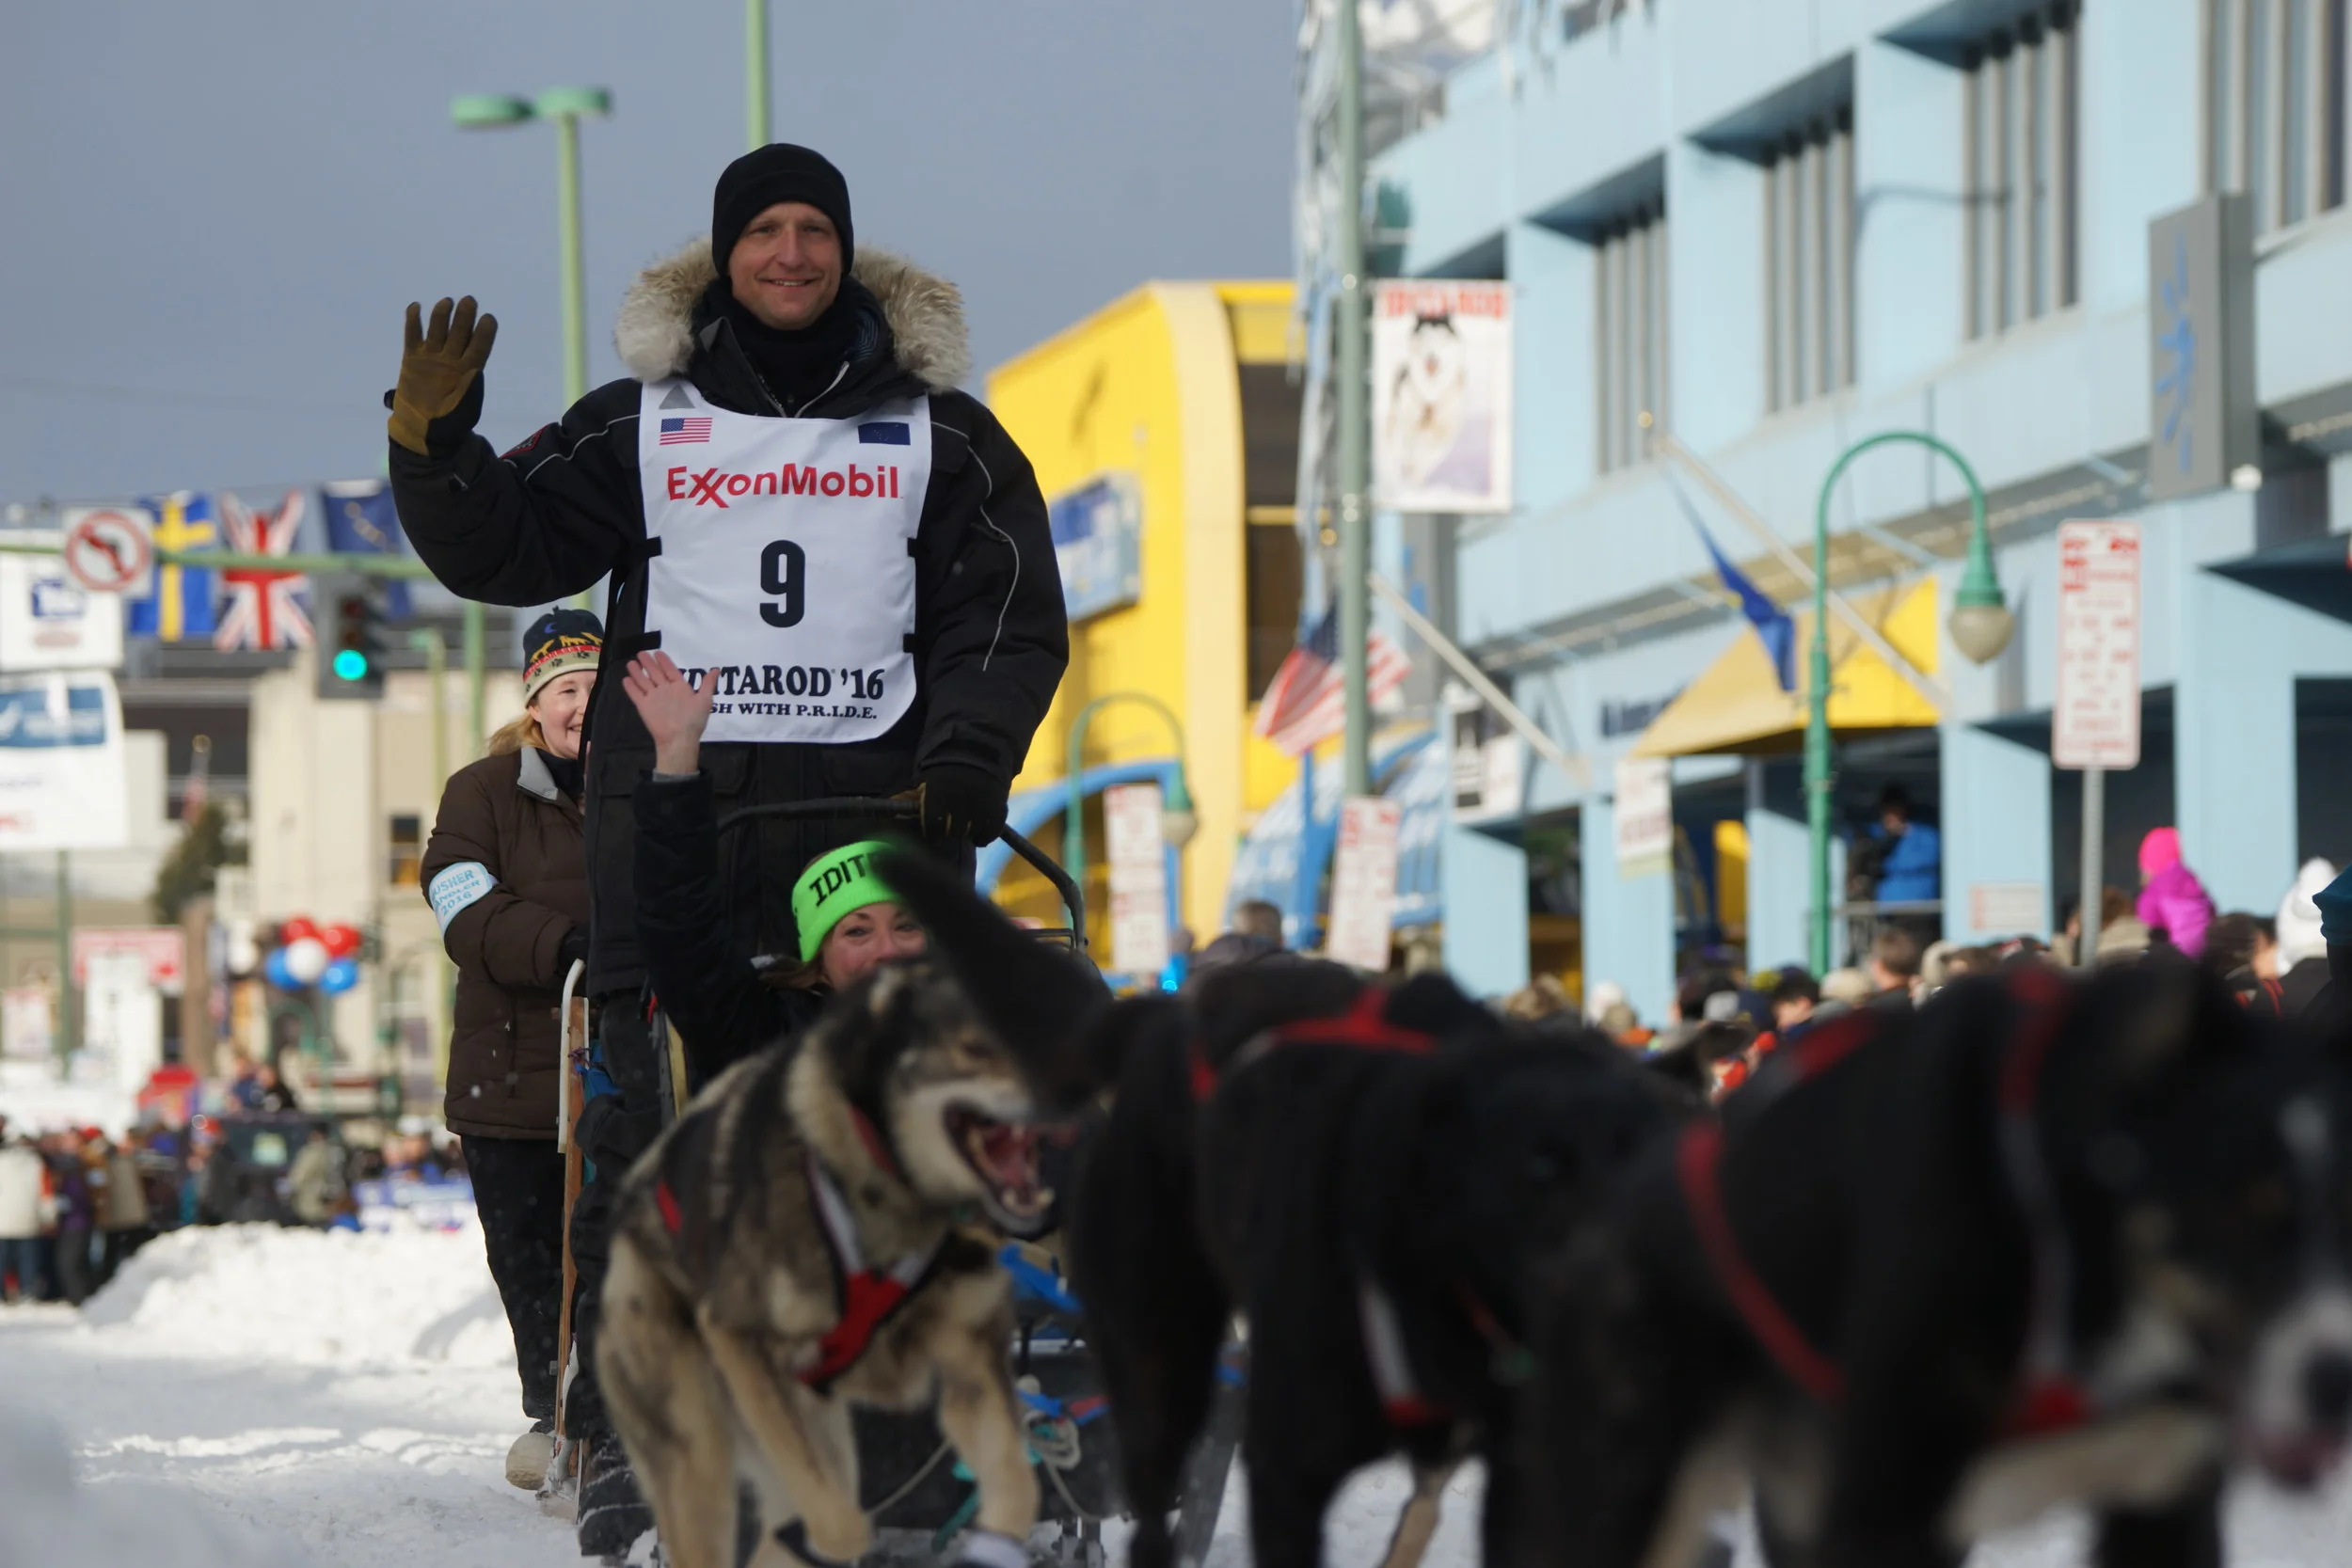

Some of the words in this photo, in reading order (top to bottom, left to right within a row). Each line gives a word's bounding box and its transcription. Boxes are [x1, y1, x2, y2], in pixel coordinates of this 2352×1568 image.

[667, 463, 899, 508] ExxonMobil
[759, 539, 806, 628] 9
[709, 703, 734, 714] SH
[738, 703, 791, 716] WITH
[796, 704, 877, 719] P.R.I.D.E.
[433, 869, 475, 897] USHER
[435, 879, 481, 908] ANDLER
[809, 853, 867, 907] IDIT
[441, 891, 472, 916] 2016
